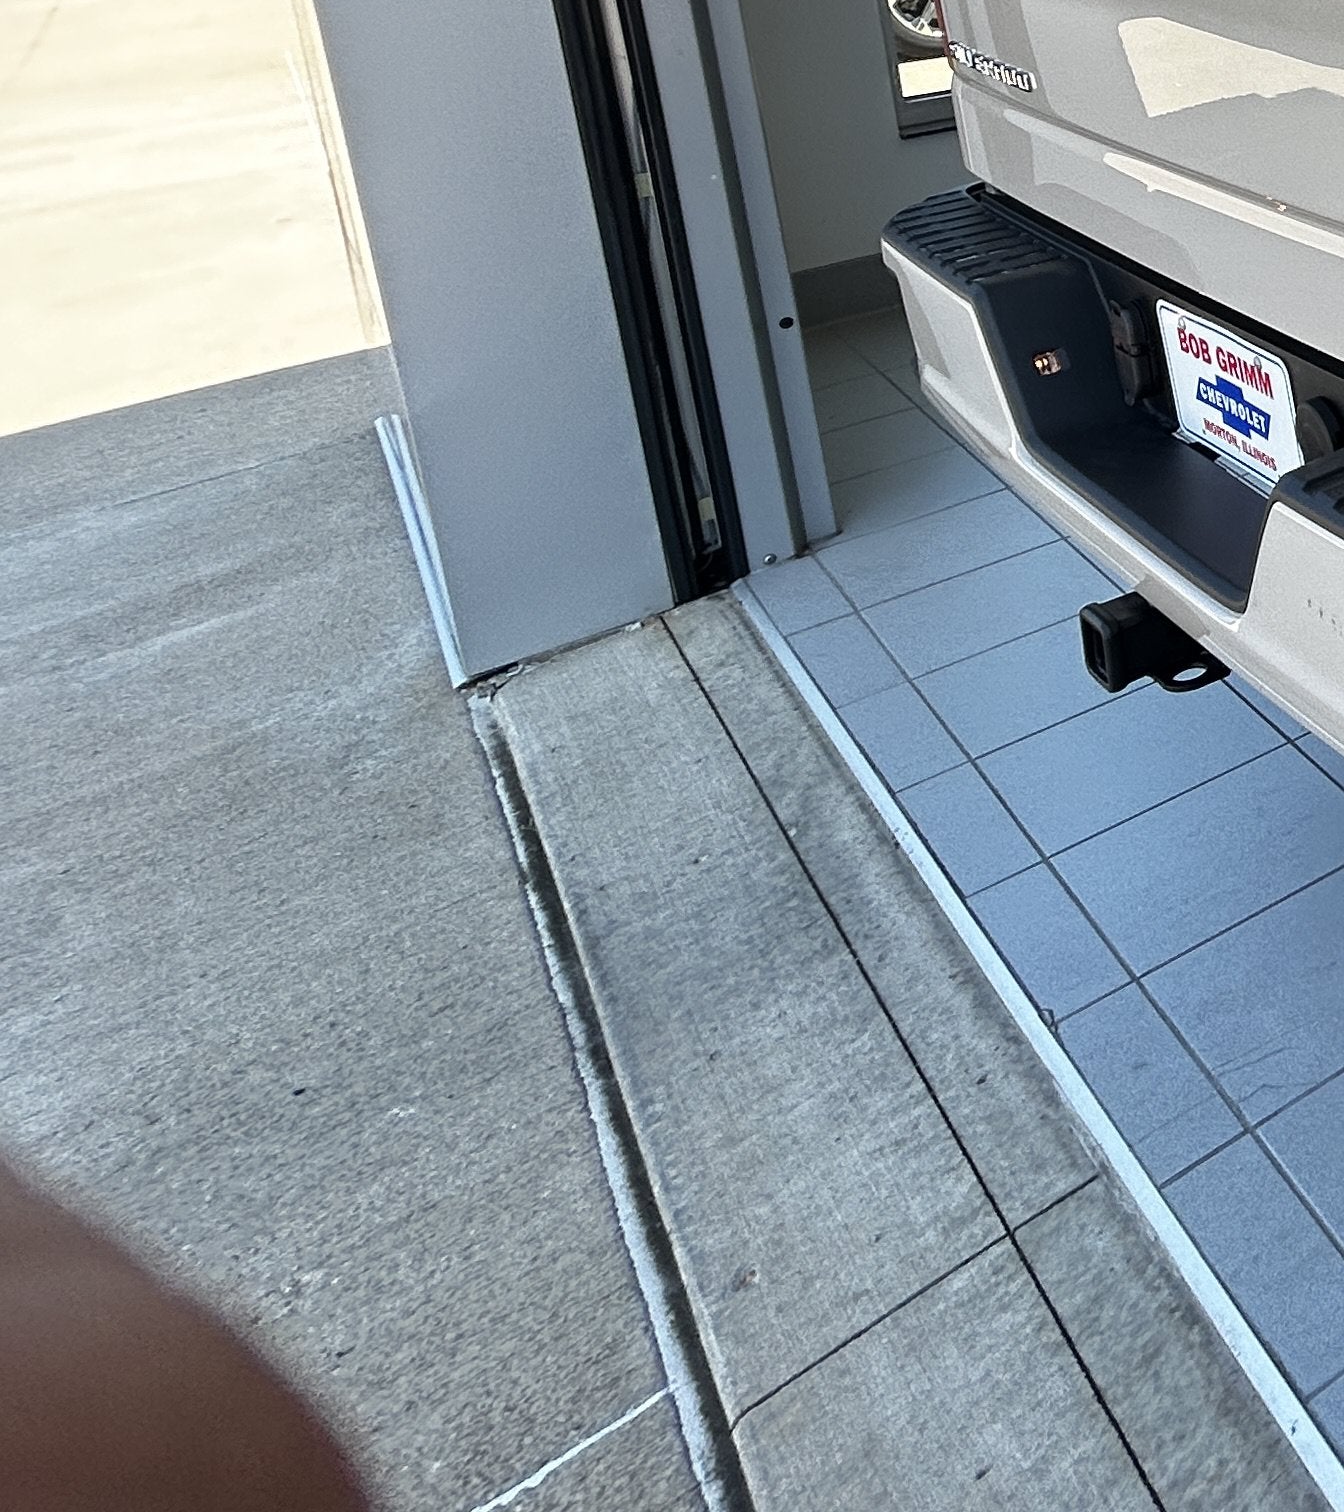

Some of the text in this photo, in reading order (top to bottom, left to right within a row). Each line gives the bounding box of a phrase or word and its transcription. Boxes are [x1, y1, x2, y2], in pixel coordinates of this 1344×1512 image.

[1177, 327, 1275, 400] BOB GRIMM
[1199, 382, 1266, 434] CHEVROLET
[1241, 439, 1278, 472] ILLINOIS
